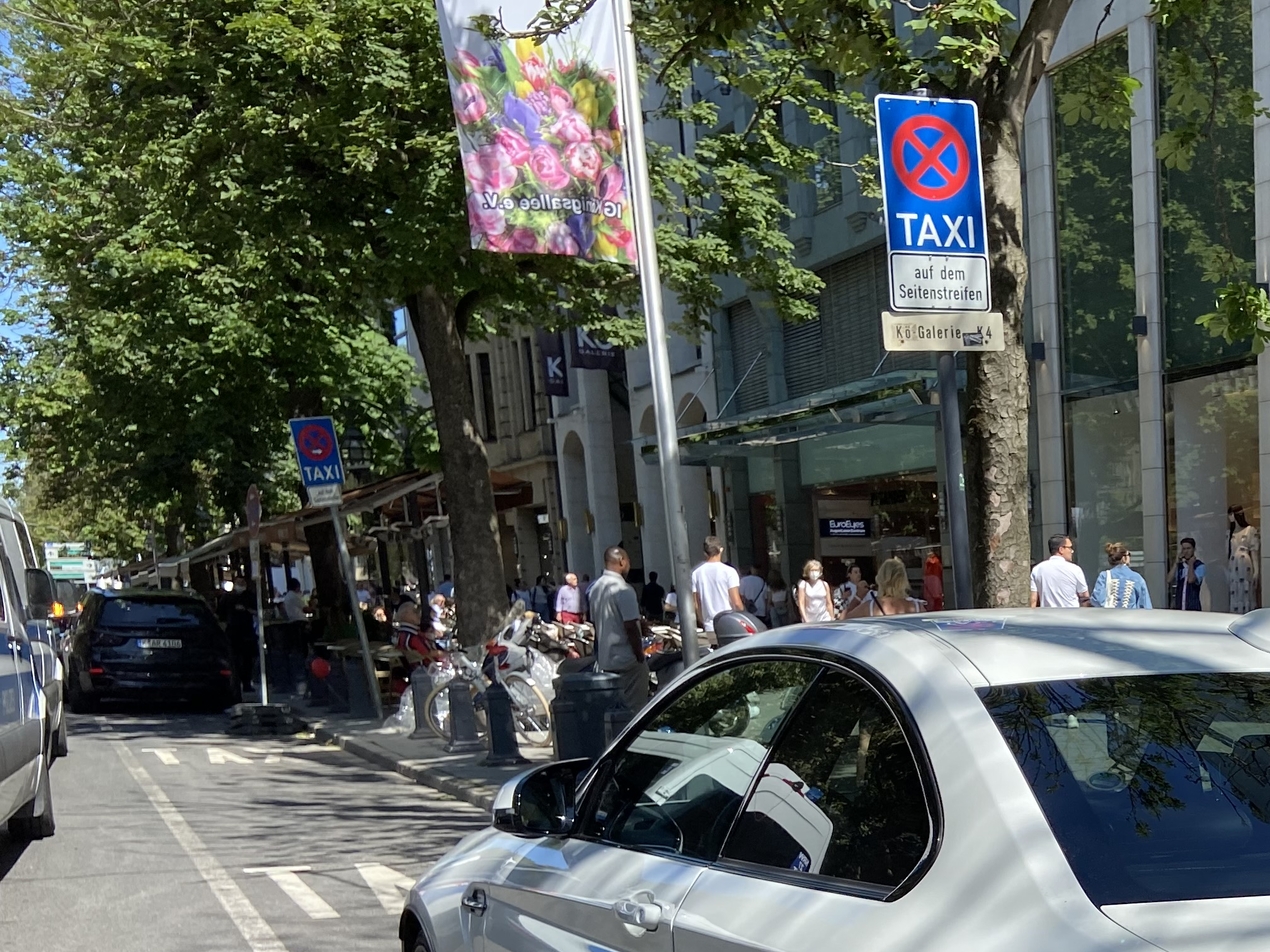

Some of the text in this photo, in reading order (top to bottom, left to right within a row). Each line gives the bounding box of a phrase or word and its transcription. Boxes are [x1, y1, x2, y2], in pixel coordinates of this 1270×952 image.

[896, 213, 975, 248] TAXI
[914, 266, 965, 281] auf dem
[899, 284, 982, 301] Seitenstreifen
[303, 464, 340, 482] TAXI
[829, 519, 865, 529] EuroEyes
